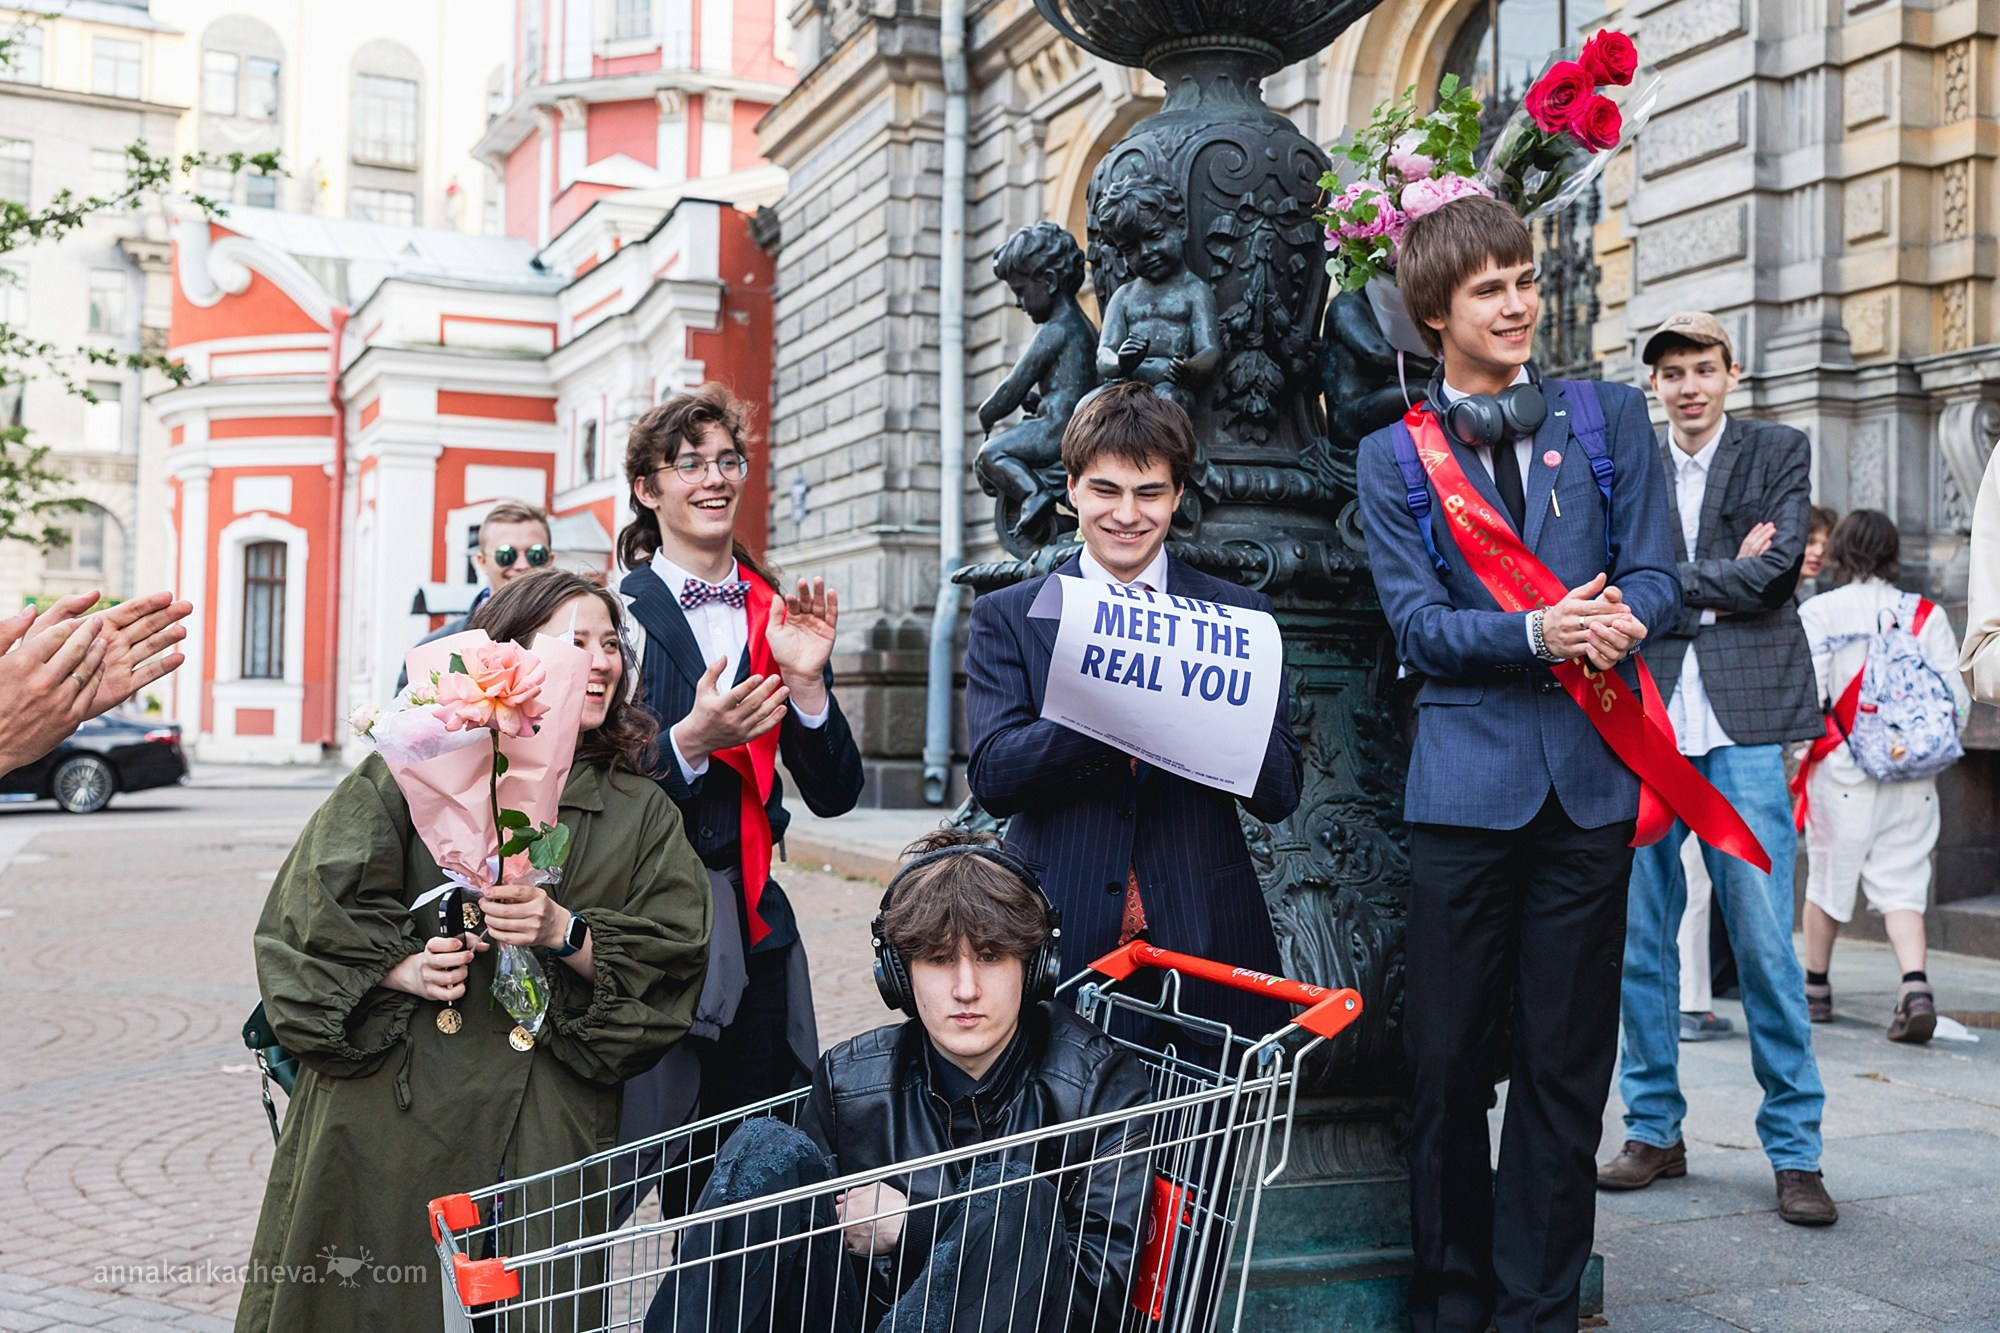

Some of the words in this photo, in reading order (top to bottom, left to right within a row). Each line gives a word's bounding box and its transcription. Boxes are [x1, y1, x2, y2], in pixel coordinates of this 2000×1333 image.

[1443, 494, 1548, 609] Выпускни
[1093, 600, 1180, 647] MEET
[1191, 618, 1250, 660] THE
[1106, 583, 1155, 604] LET
[1168, 594, 1232, 619] LIFE
[1080, 644, 1163, 692] REAL
[1180, 660, 1251, 706] YOU
